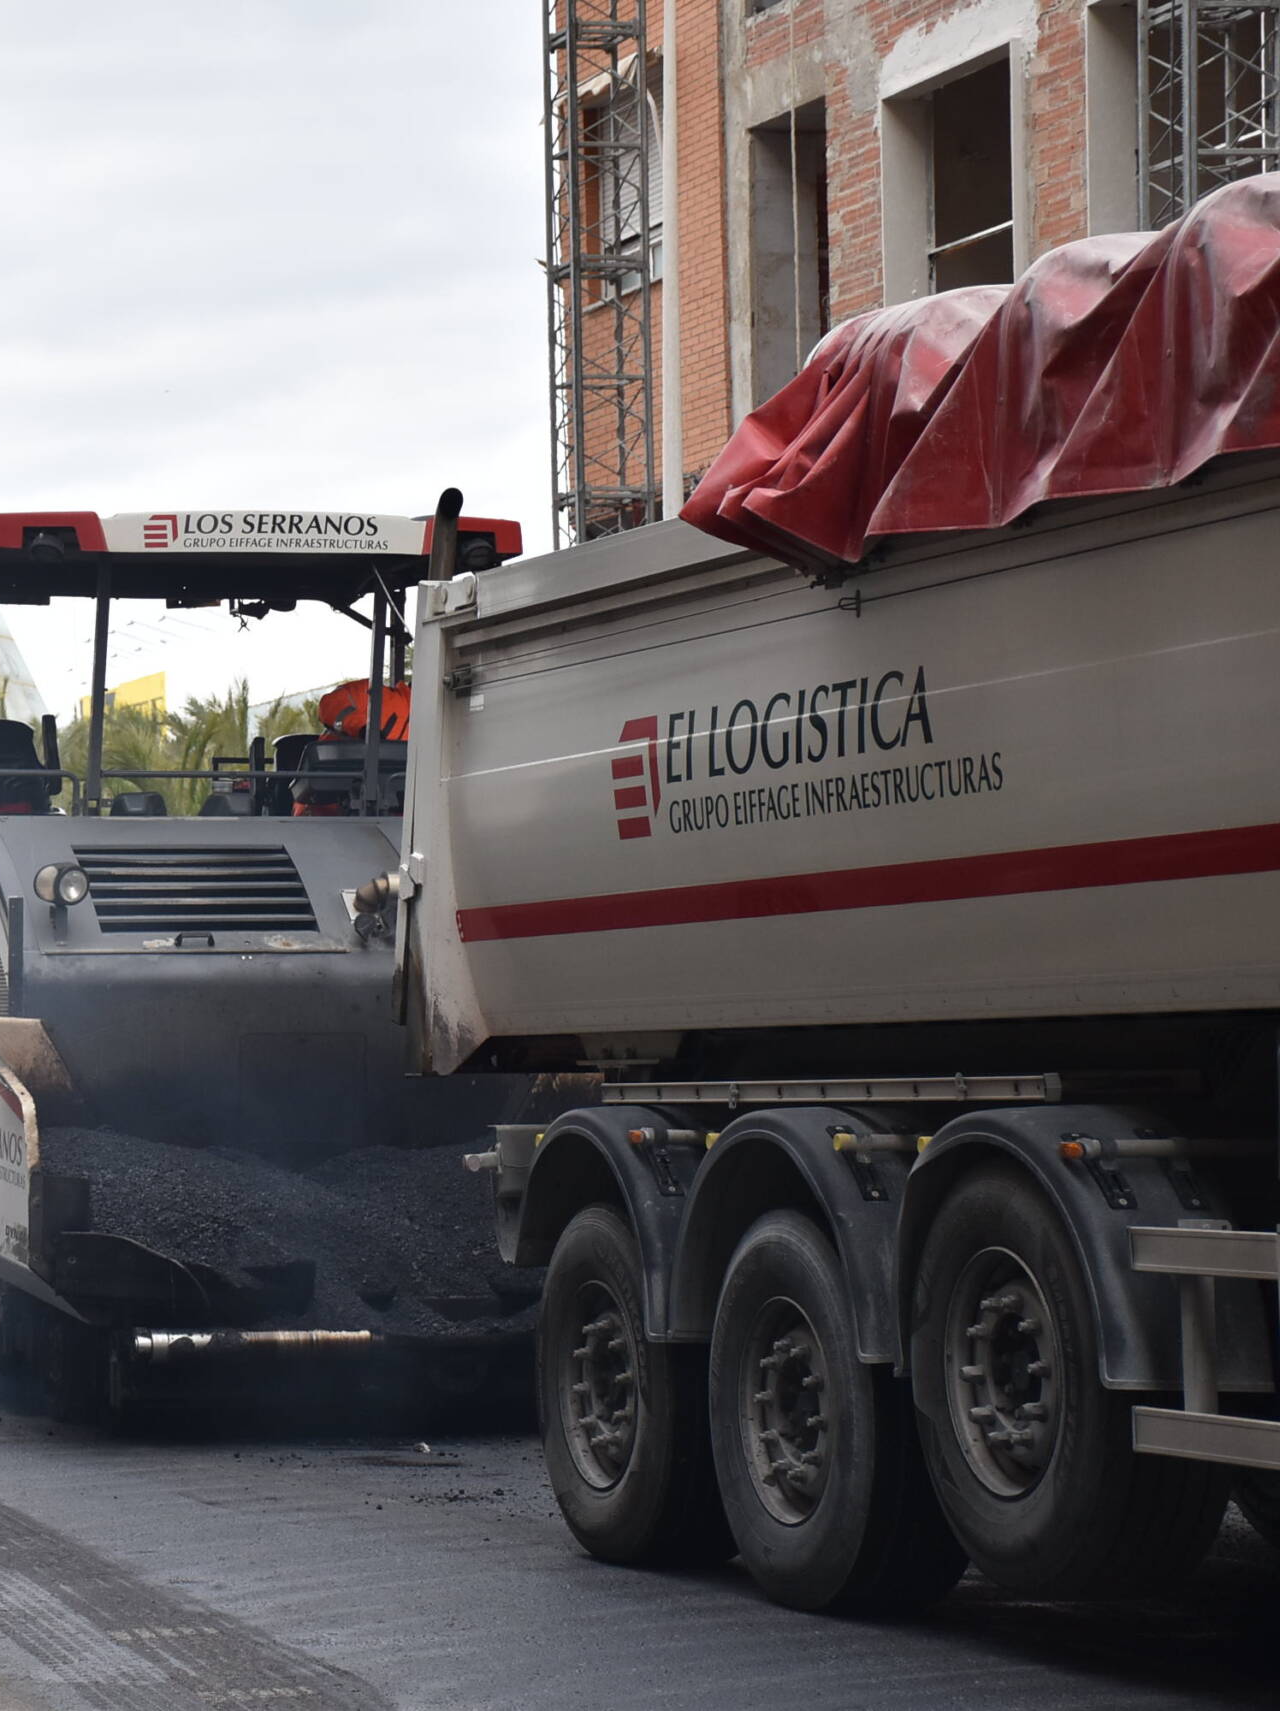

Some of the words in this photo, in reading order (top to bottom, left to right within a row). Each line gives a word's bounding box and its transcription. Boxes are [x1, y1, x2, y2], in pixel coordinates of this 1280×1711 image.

[183, 514, 233, 534] LOS
[241, 514, 379, 536] SERRANOS
[183, 537, 227, 548] GRUPO
[229, 537, 273, 549] EIFFAGE
[276, 537, 389, 551] INFRAESTRUCTURAS
[708, 665, 933, 777] LOGISTICA
[669, 793, 729, 834] GRUPO
[735, 783, 801, 826] EIFFAGE
[805, 751, 1004, 816] INFRAESTRUCTURAS
